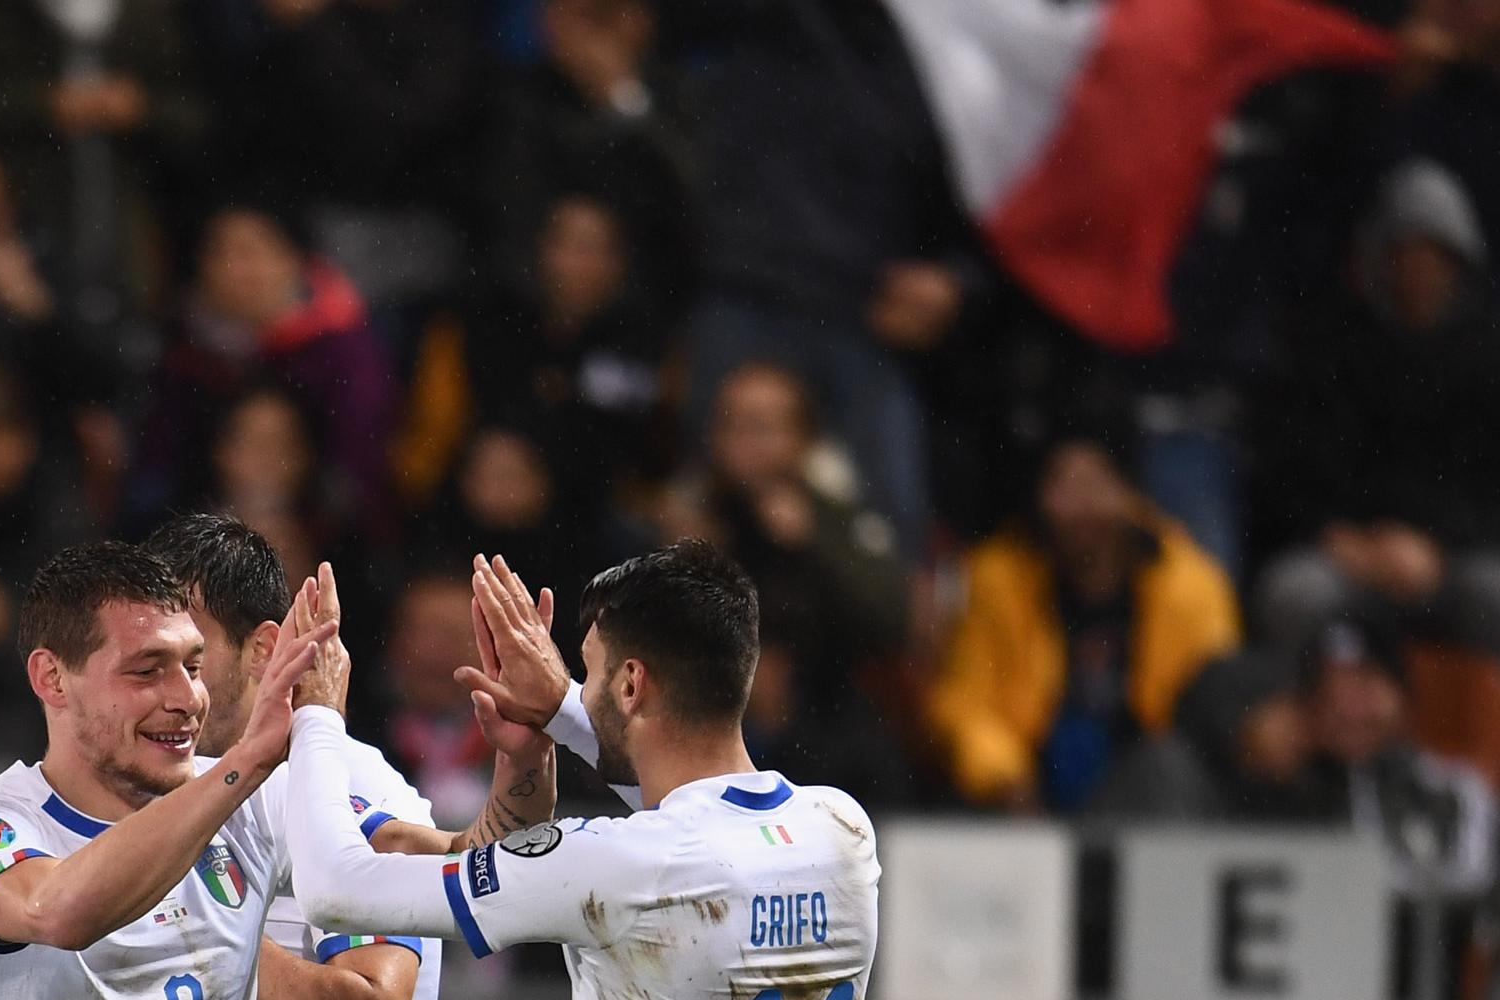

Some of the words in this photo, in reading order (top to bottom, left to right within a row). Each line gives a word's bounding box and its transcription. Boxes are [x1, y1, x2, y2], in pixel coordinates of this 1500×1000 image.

[474, 845, 493, 894] ESPECT
[750, 891, 829, 948] GRIFO
[1216, 860, 1296, 993] E
